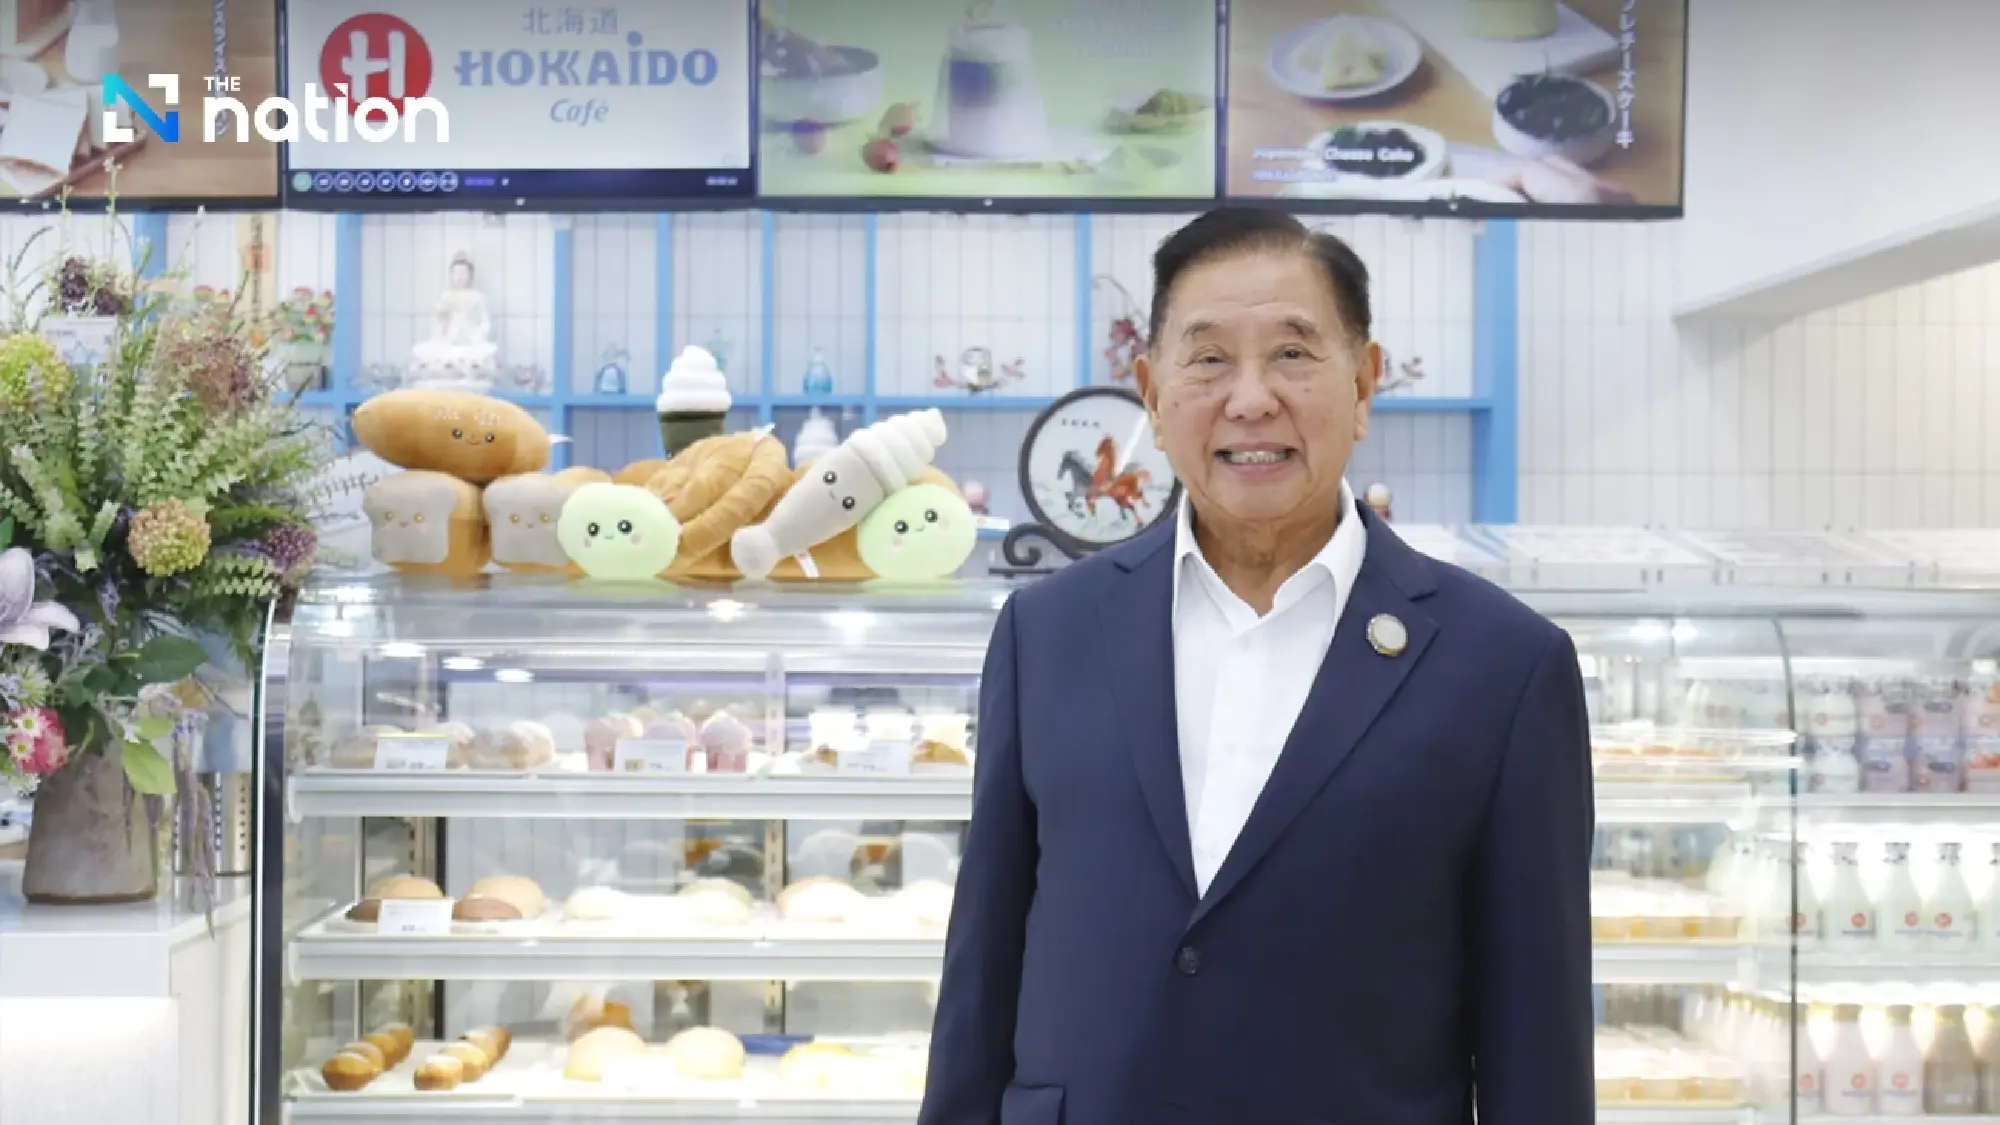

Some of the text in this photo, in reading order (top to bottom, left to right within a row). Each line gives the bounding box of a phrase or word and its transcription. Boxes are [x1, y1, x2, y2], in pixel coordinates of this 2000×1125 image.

[522, 7, 619, 35] 北海道
[550, 98, 609, 126] Café
